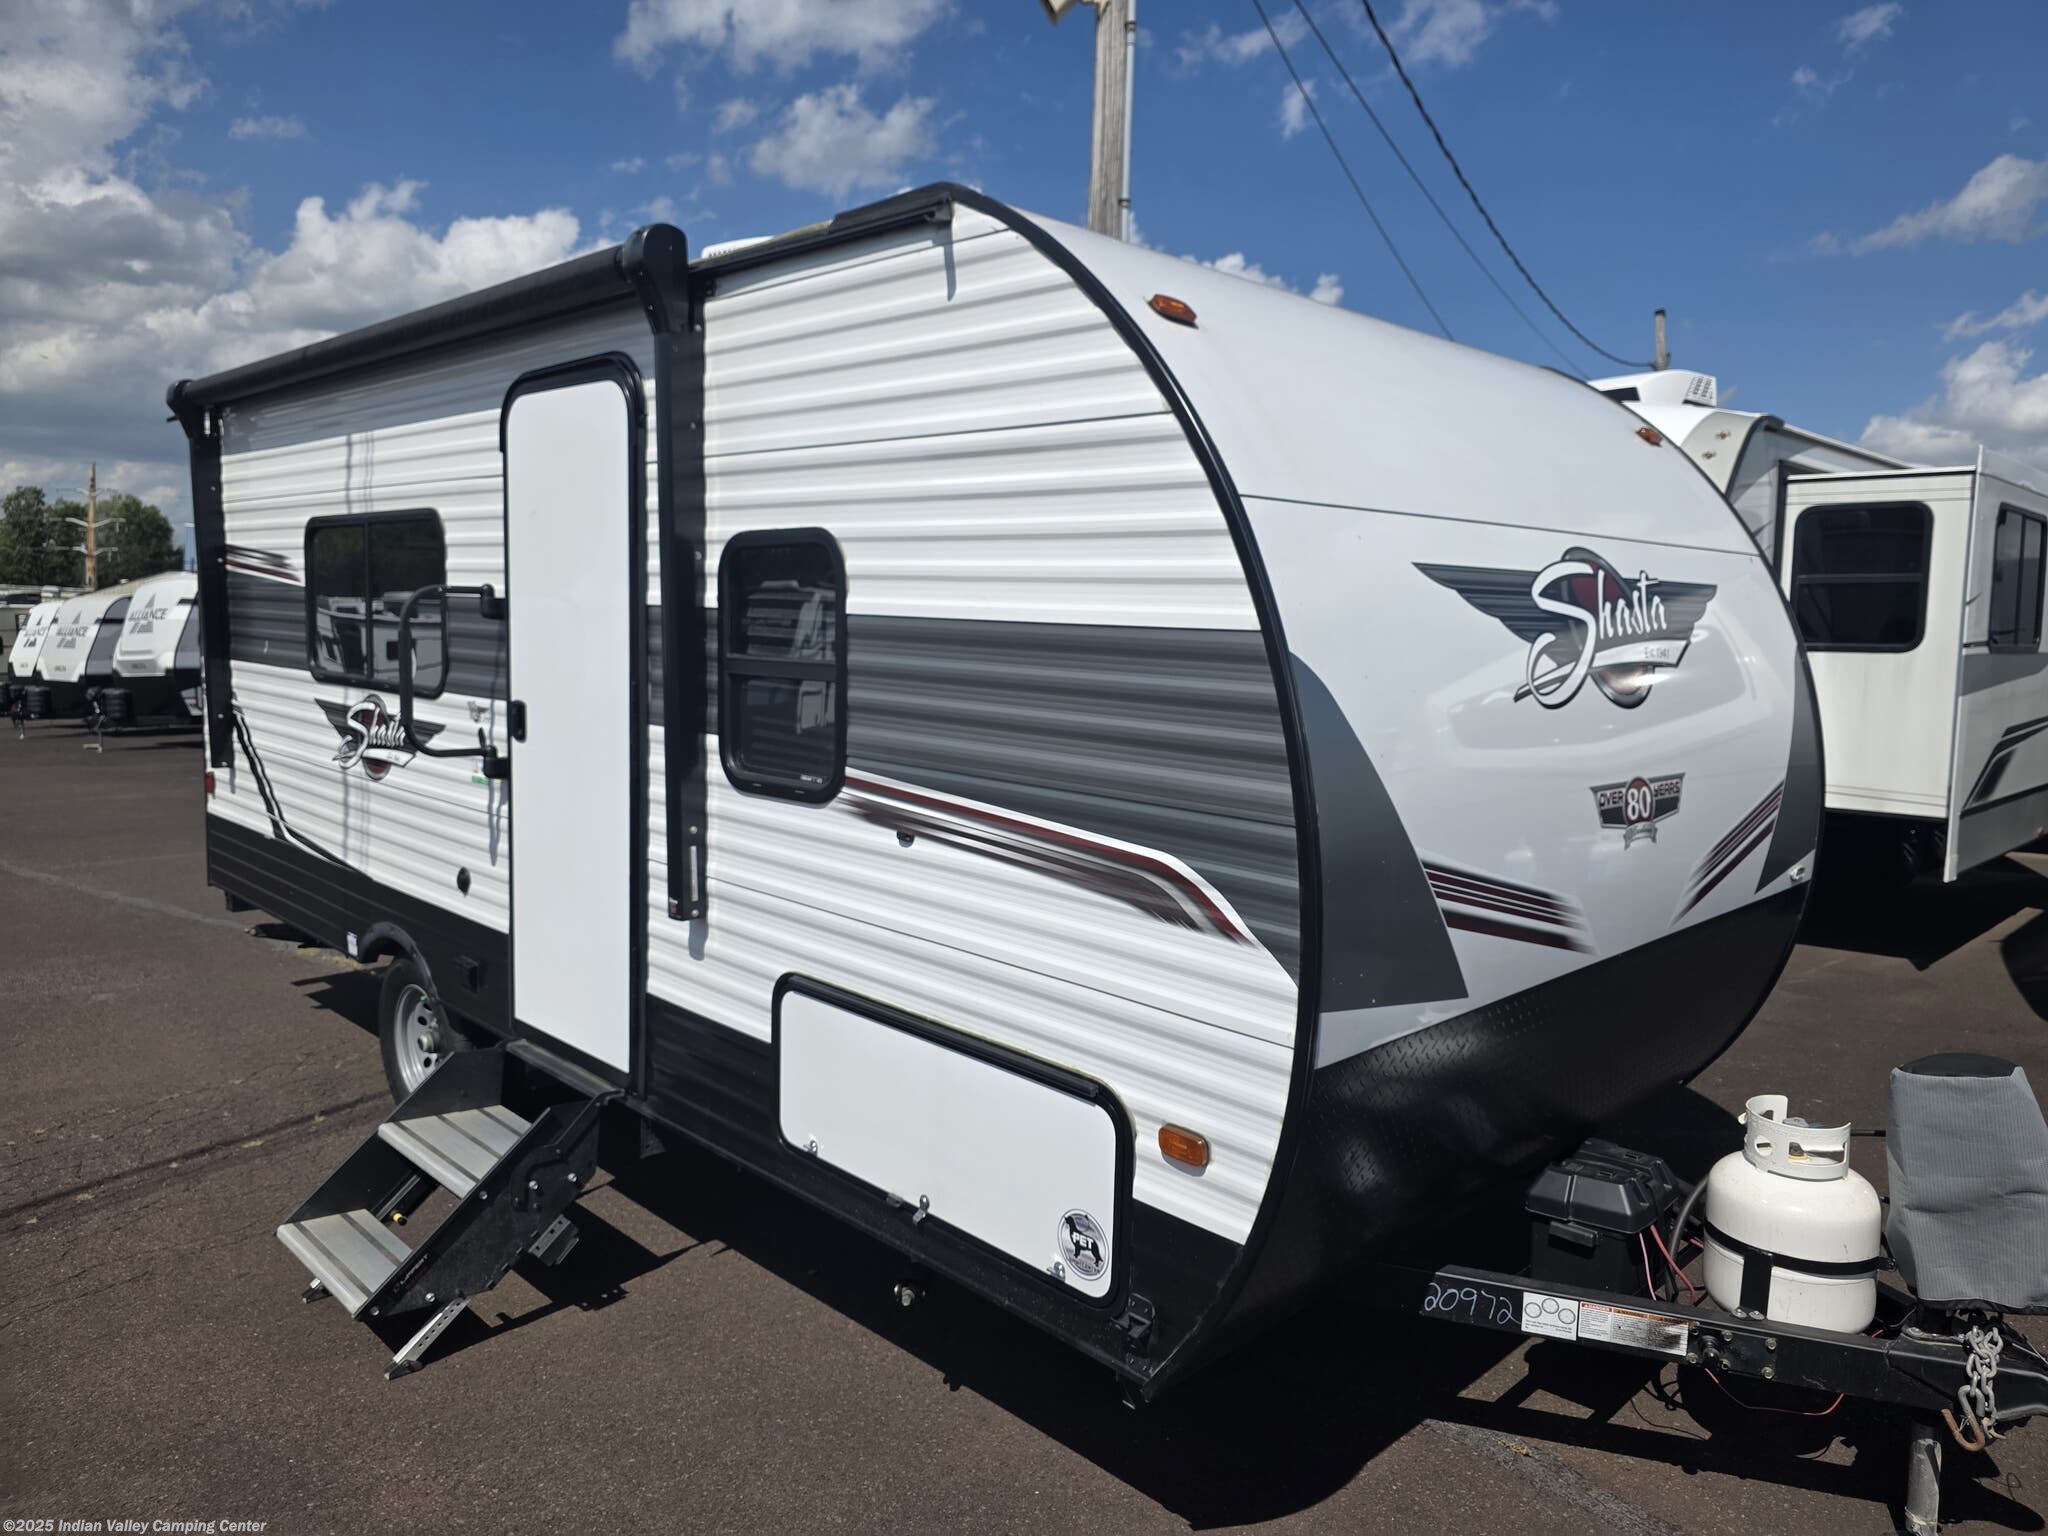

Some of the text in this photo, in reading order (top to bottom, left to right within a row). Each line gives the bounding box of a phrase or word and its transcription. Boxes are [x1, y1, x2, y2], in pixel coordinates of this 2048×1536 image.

[127, 608, 168, 621] ALLIANCE
[55, 624, 89, 638] ALLIANCE
[1526, 560, 1668, 710] Shasta
[1599, 780, 1681, 821] OVER 80 YEARS
[1071, 1230, 1094, 1249] PET
[1424, 1281, 1521, 1324] 20972
